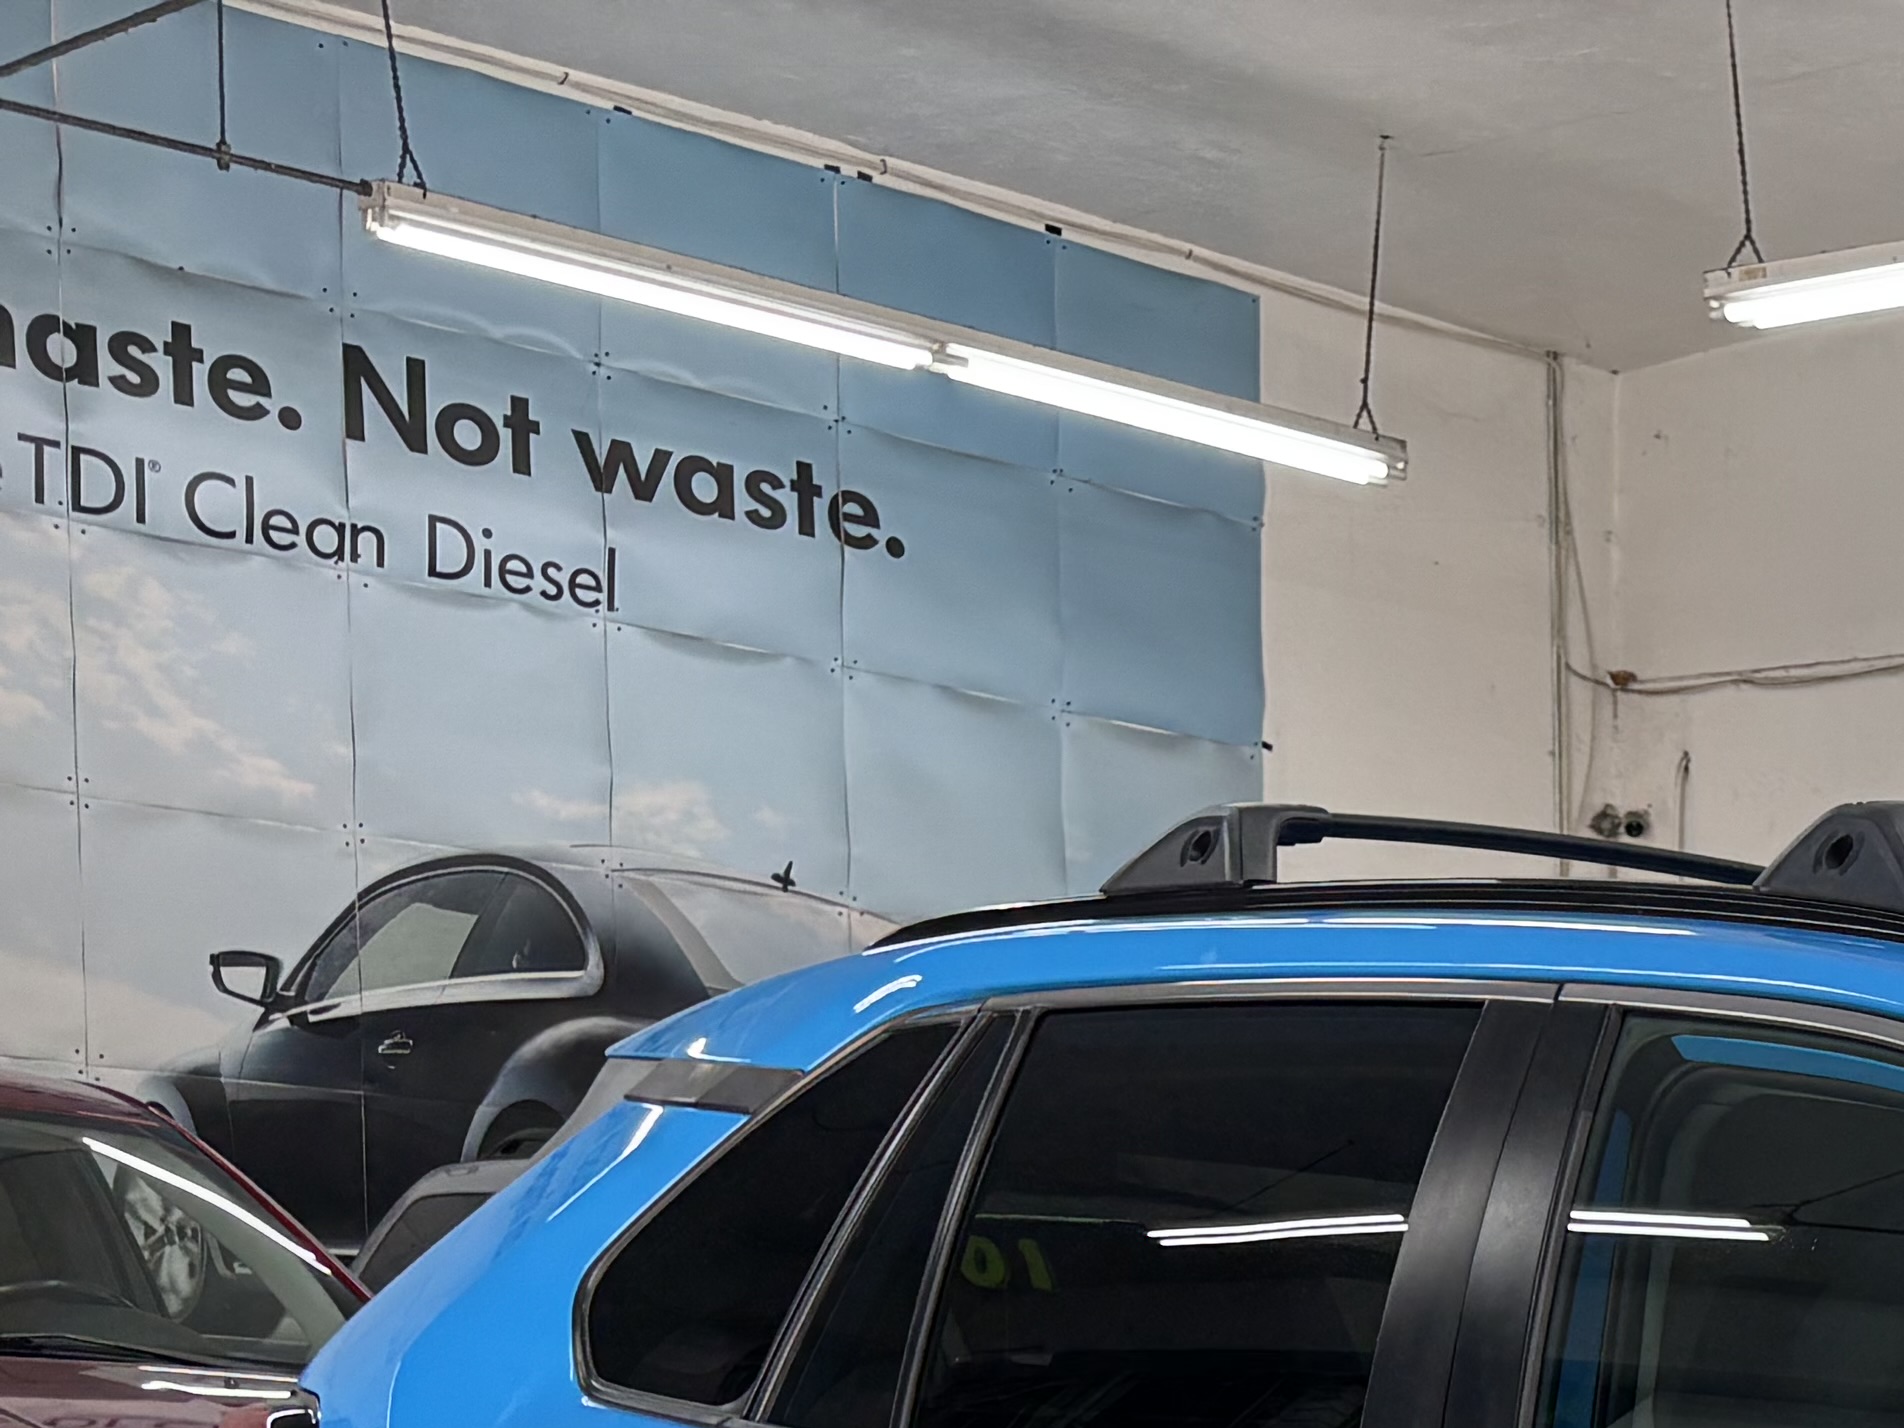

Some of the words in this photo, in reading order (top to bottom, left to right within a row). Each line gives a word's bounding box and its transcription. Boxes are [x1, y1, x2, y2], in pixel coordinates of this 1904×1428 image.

[0, 303, 303, 431] aste.
[341, 342, 541, 477] Not
[570, 428, 906, 560] waste.
[184, 470, 387, 569] Clean
[427, 514, 620, 613] Diesel
